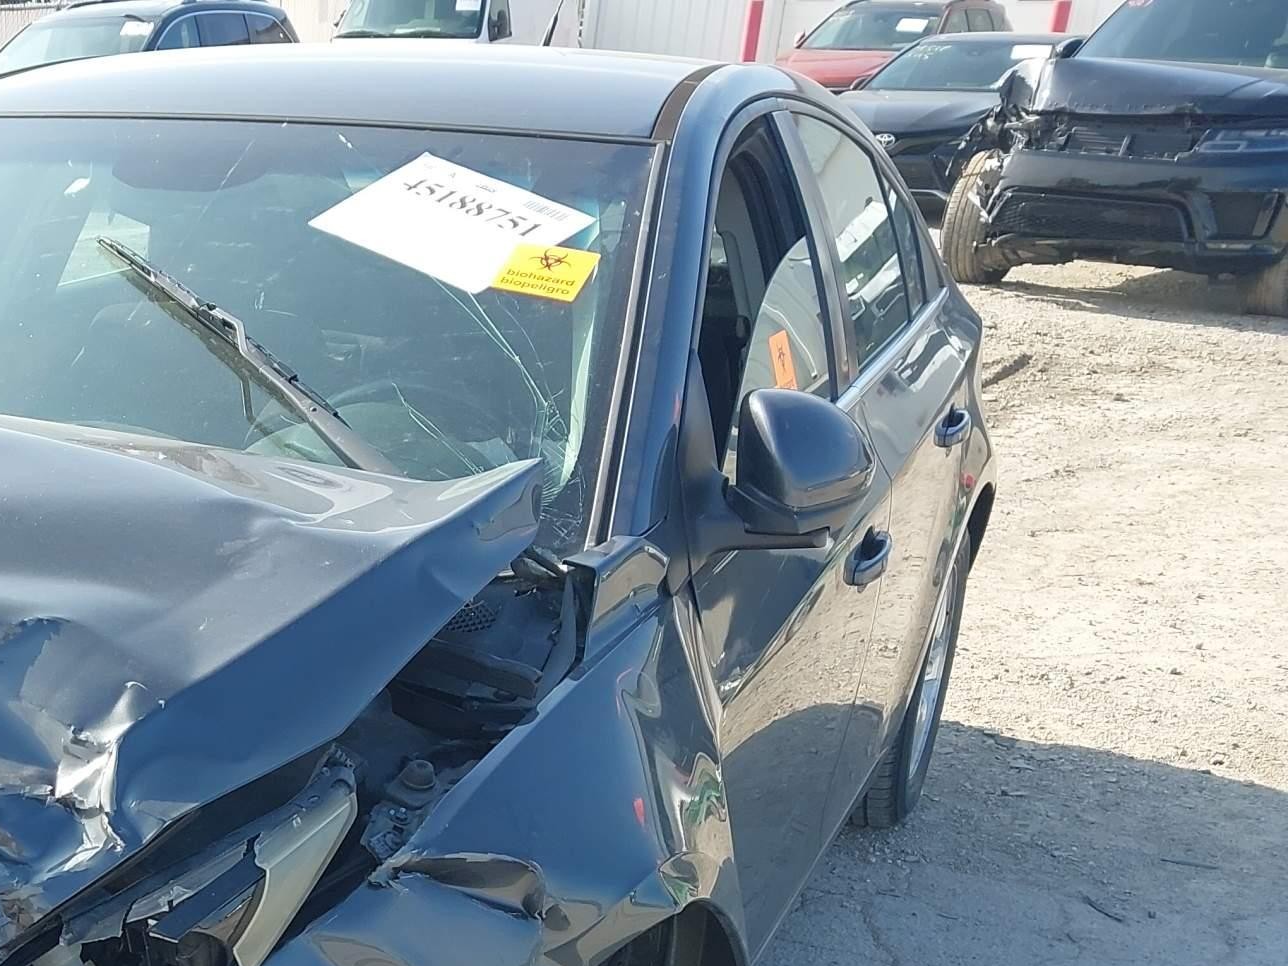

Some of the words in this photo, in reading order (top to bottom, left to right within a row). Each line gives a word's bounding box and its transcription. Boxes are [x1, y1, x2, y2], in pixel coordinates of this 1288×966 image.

[403, 178, 542, 237] 45188751
[500, 277, 571, 296] biopeligro
[506, 268, 575, 287] biohazard
